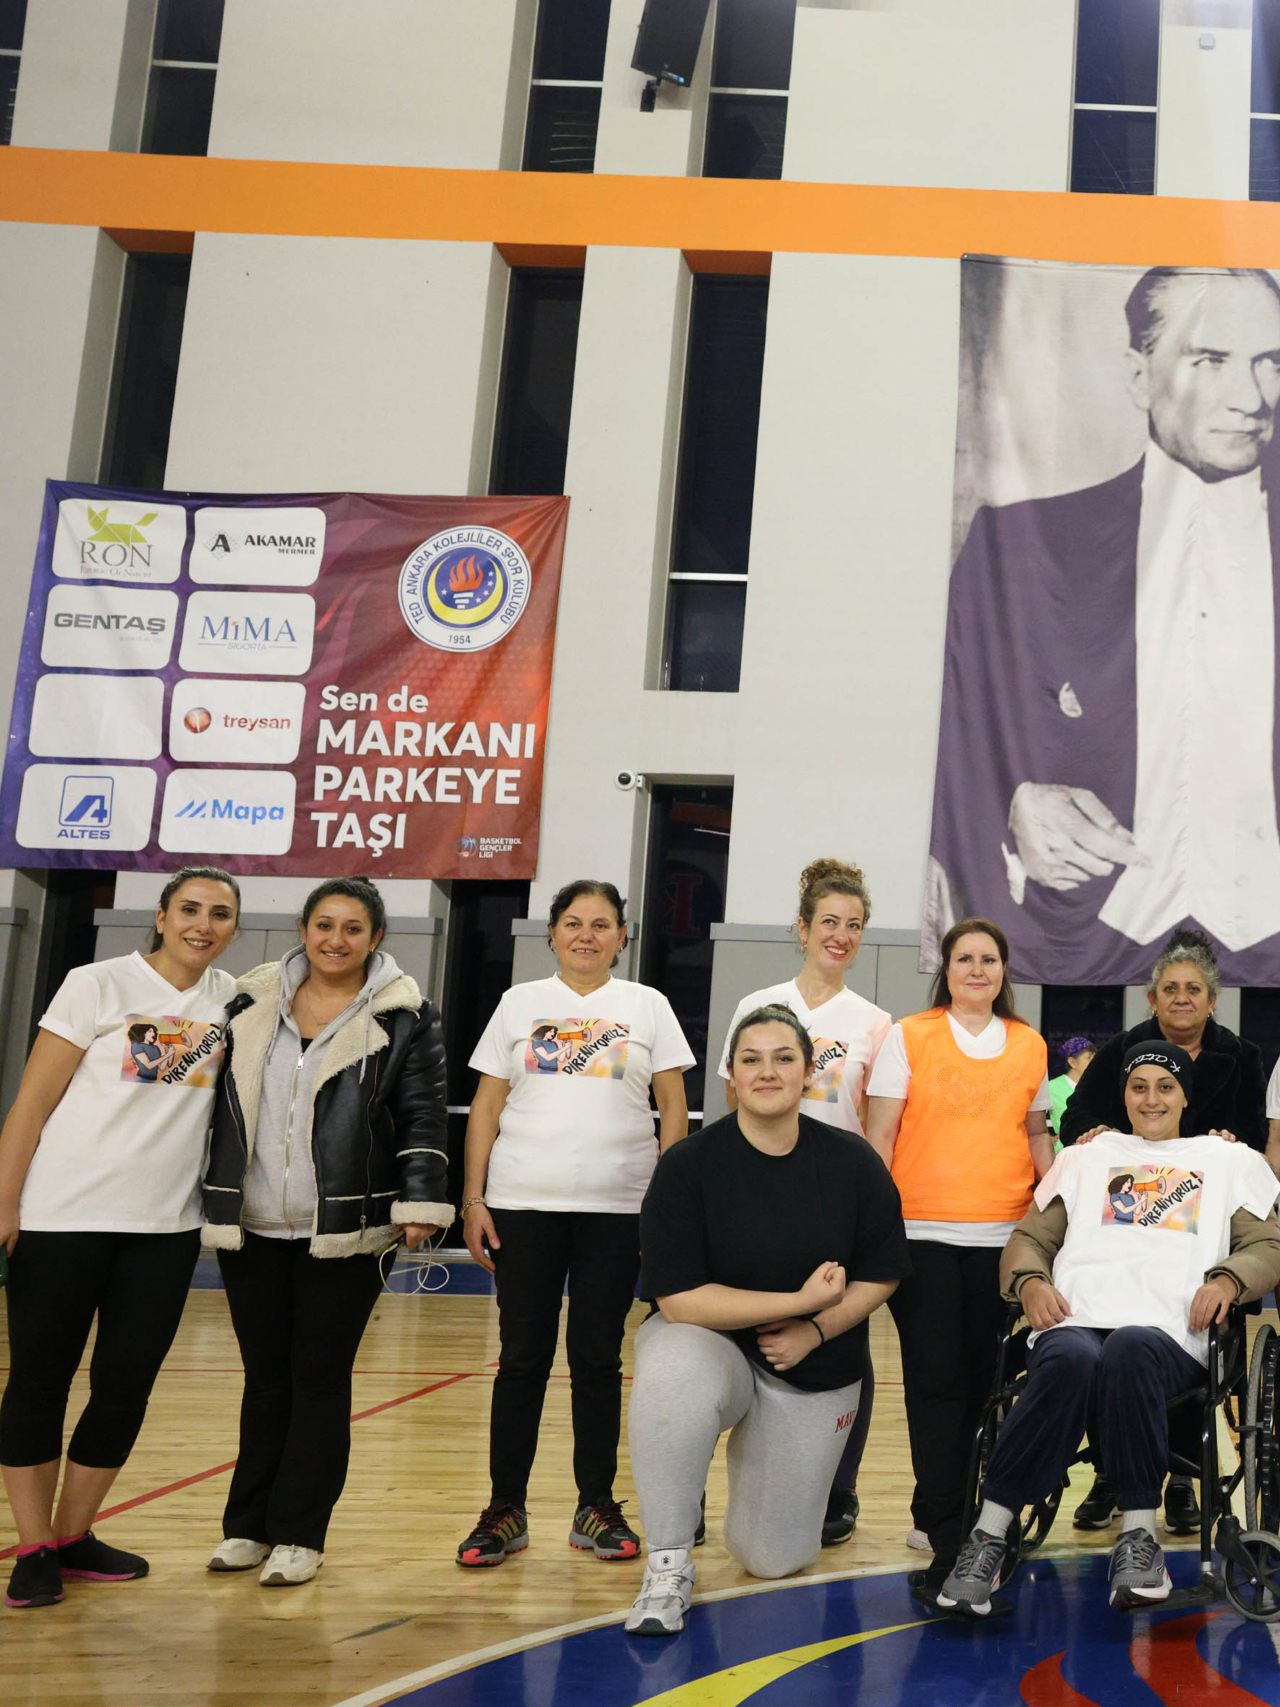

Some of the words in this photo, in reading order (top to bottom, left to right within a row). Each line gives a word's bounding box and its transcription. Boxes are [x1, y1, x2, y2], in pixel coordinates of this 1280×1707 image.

[80, 541, 153, 567] RON
[244, 535, 316, 547] AKAMAR
[406, 550, 433, 595] ANKARA
[501, 547, 522, 575] SPOR
[408, 602, 425, 624] TED
[500, 579, 525, 625] KULÜBÜ
[54, 613, 166, 634] GENTAŞ
[448, 635, 471, 644] 1954
[320, 685, 378, 711] Sen
[387, 685, 429, 713] de
[223, 714, 291, 732] treysan
[317, 719, 536, 758] MARKANI
[314, 765, 521, 804] PARKEYE
[211, 799, 284, 825] Mapa
[57, 829, 110, 839] ALTES
[310, 812, 407, 857] TAŞI
[480, 845, 513, 853] GENÇLER
